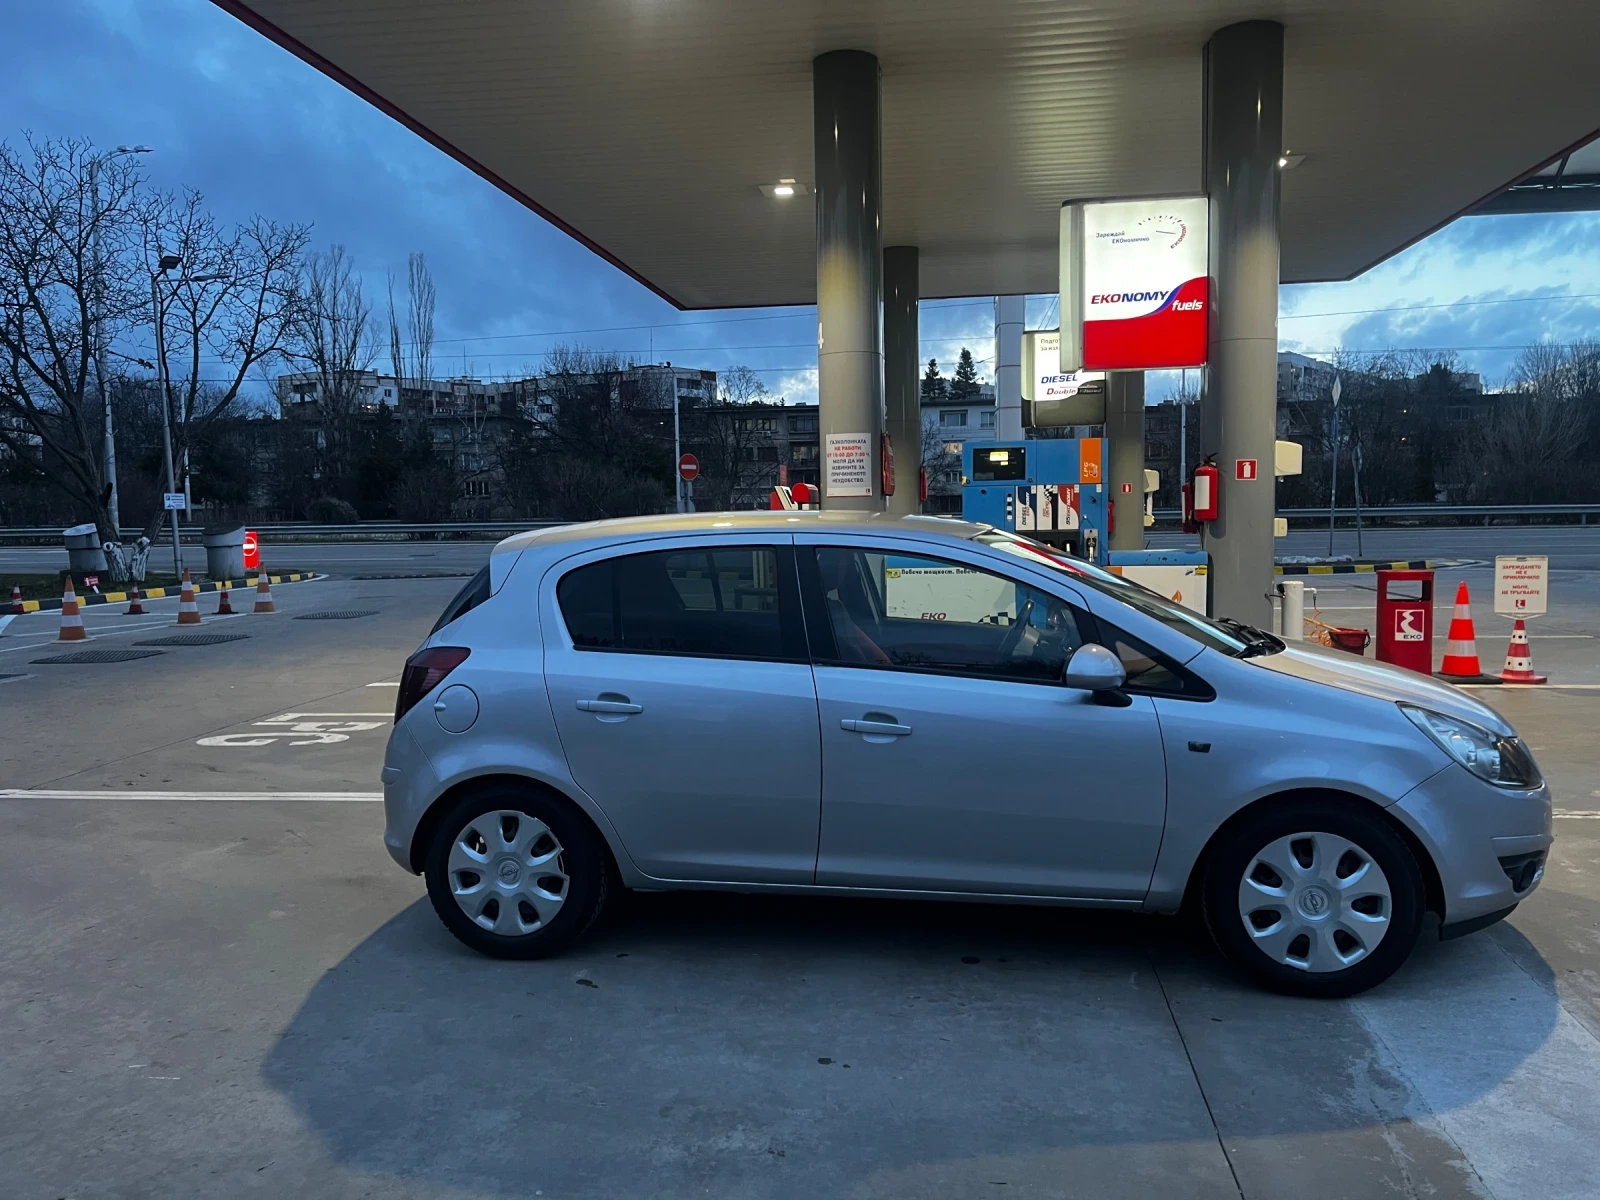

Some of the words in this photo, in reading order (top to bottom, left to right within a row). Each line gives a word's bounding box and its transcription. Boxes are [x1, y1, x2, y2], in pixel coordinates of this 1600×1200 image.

[1091, 291, 1169, 304] EKONOMY
[1172, 299, 1203, 311] fuels
[1041, 375, 1078, 383] DIESEL
